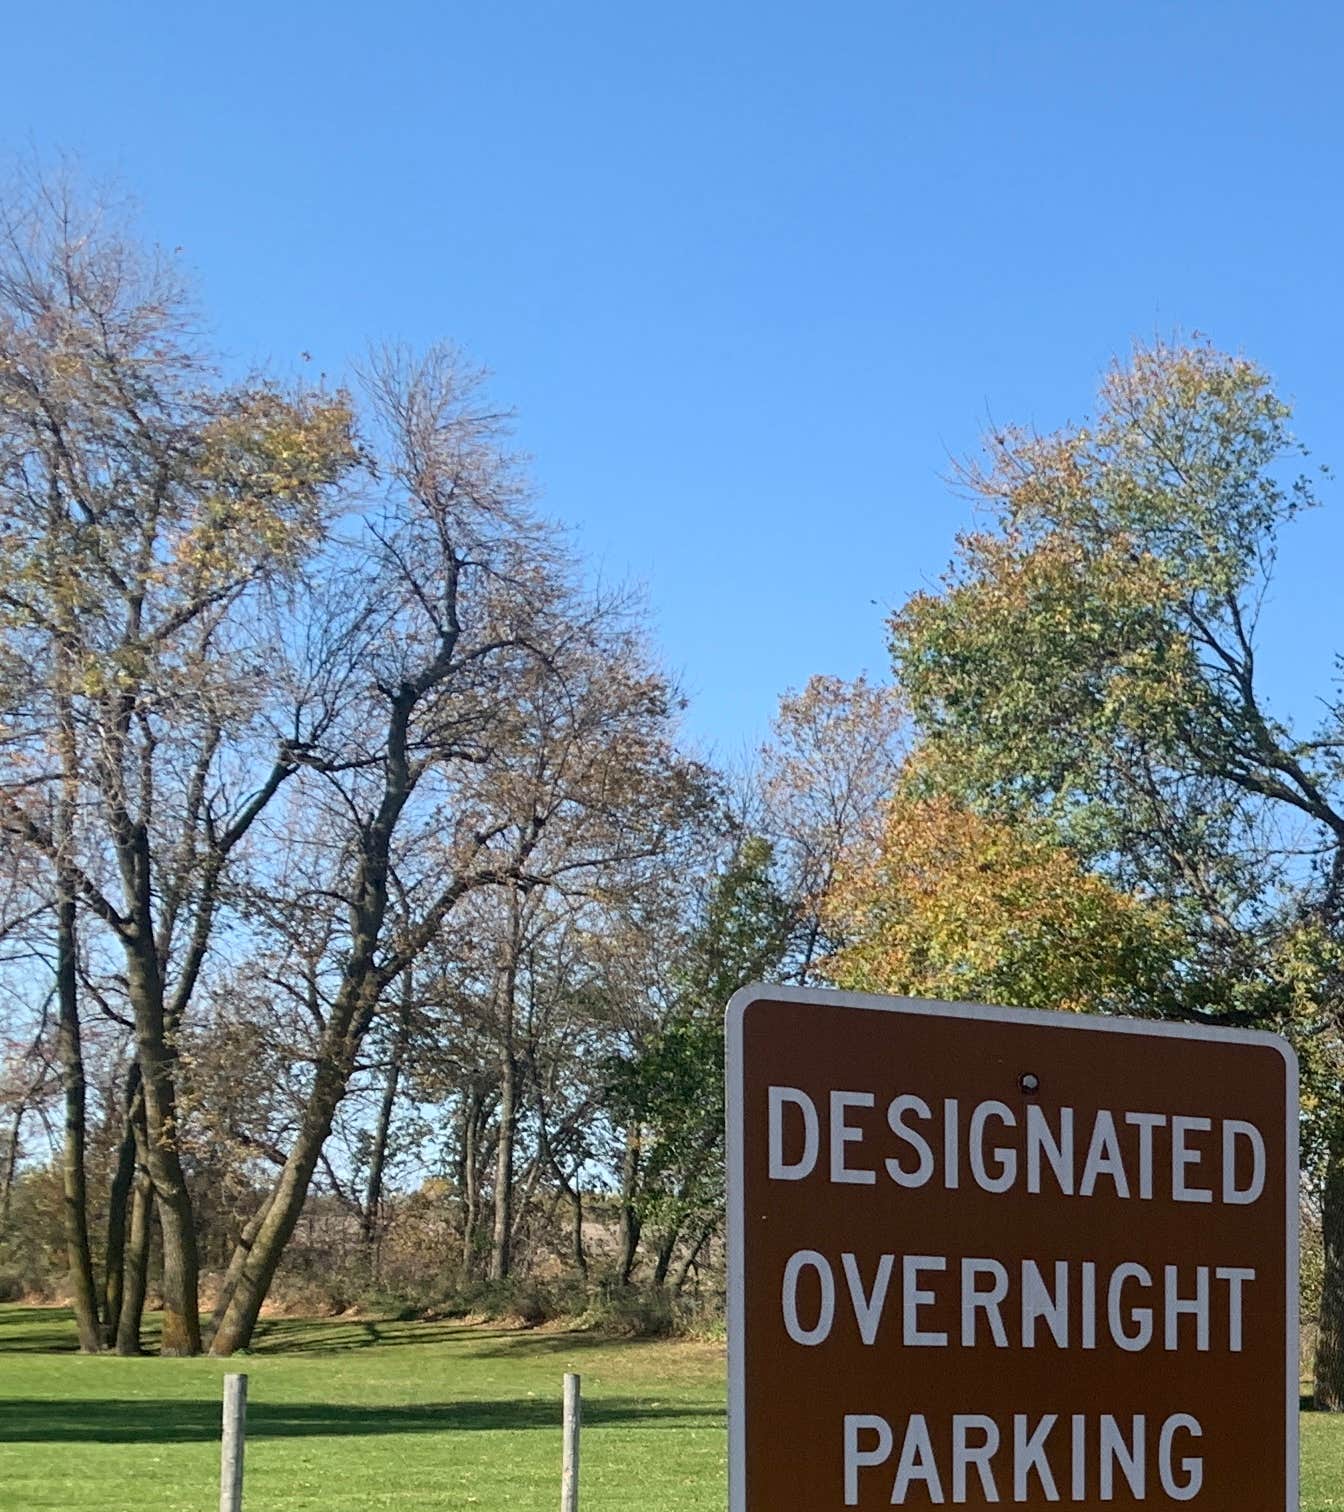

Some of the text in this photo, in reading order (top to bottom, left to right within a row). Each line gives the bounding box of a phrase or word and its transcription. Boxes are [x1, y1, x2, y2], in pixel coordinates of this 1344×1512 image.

[768, 1086, 1267, 1205] DESIGNATED
[782, 1249, 1255, 1353] OVERNIGHT
[844, 1413, 1203, 1506] PARKING
